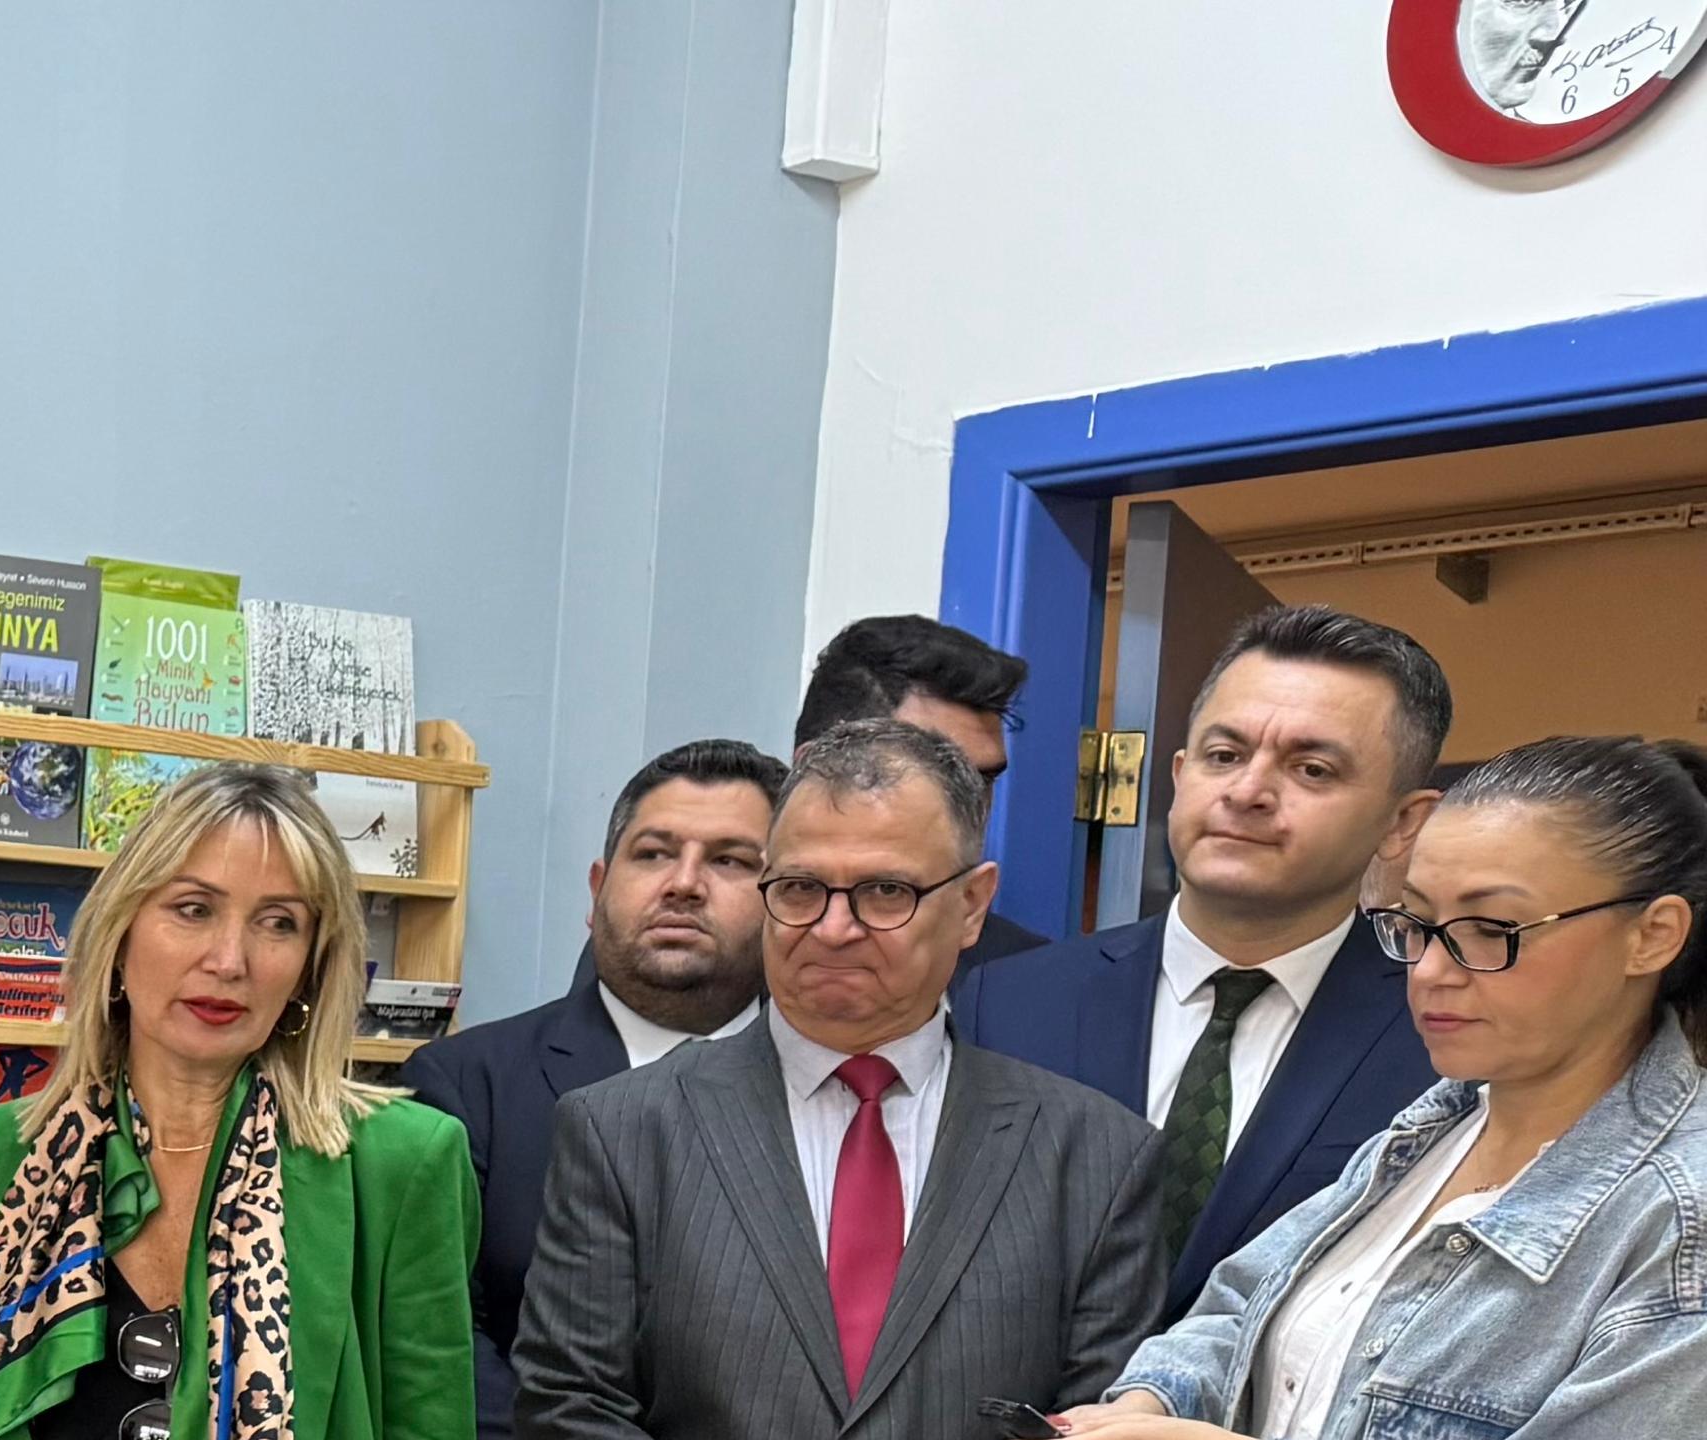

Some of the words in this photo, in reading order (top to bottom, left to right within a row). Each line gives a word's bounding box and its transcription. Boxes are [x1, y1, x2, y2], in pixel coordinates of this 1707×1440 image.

[1659, 26, 1677, 55] 4
[1613, 67, 1633, 97] 5
[1561, 85, 1578, 115] 6
[145, 615, 207, 664] 1001
